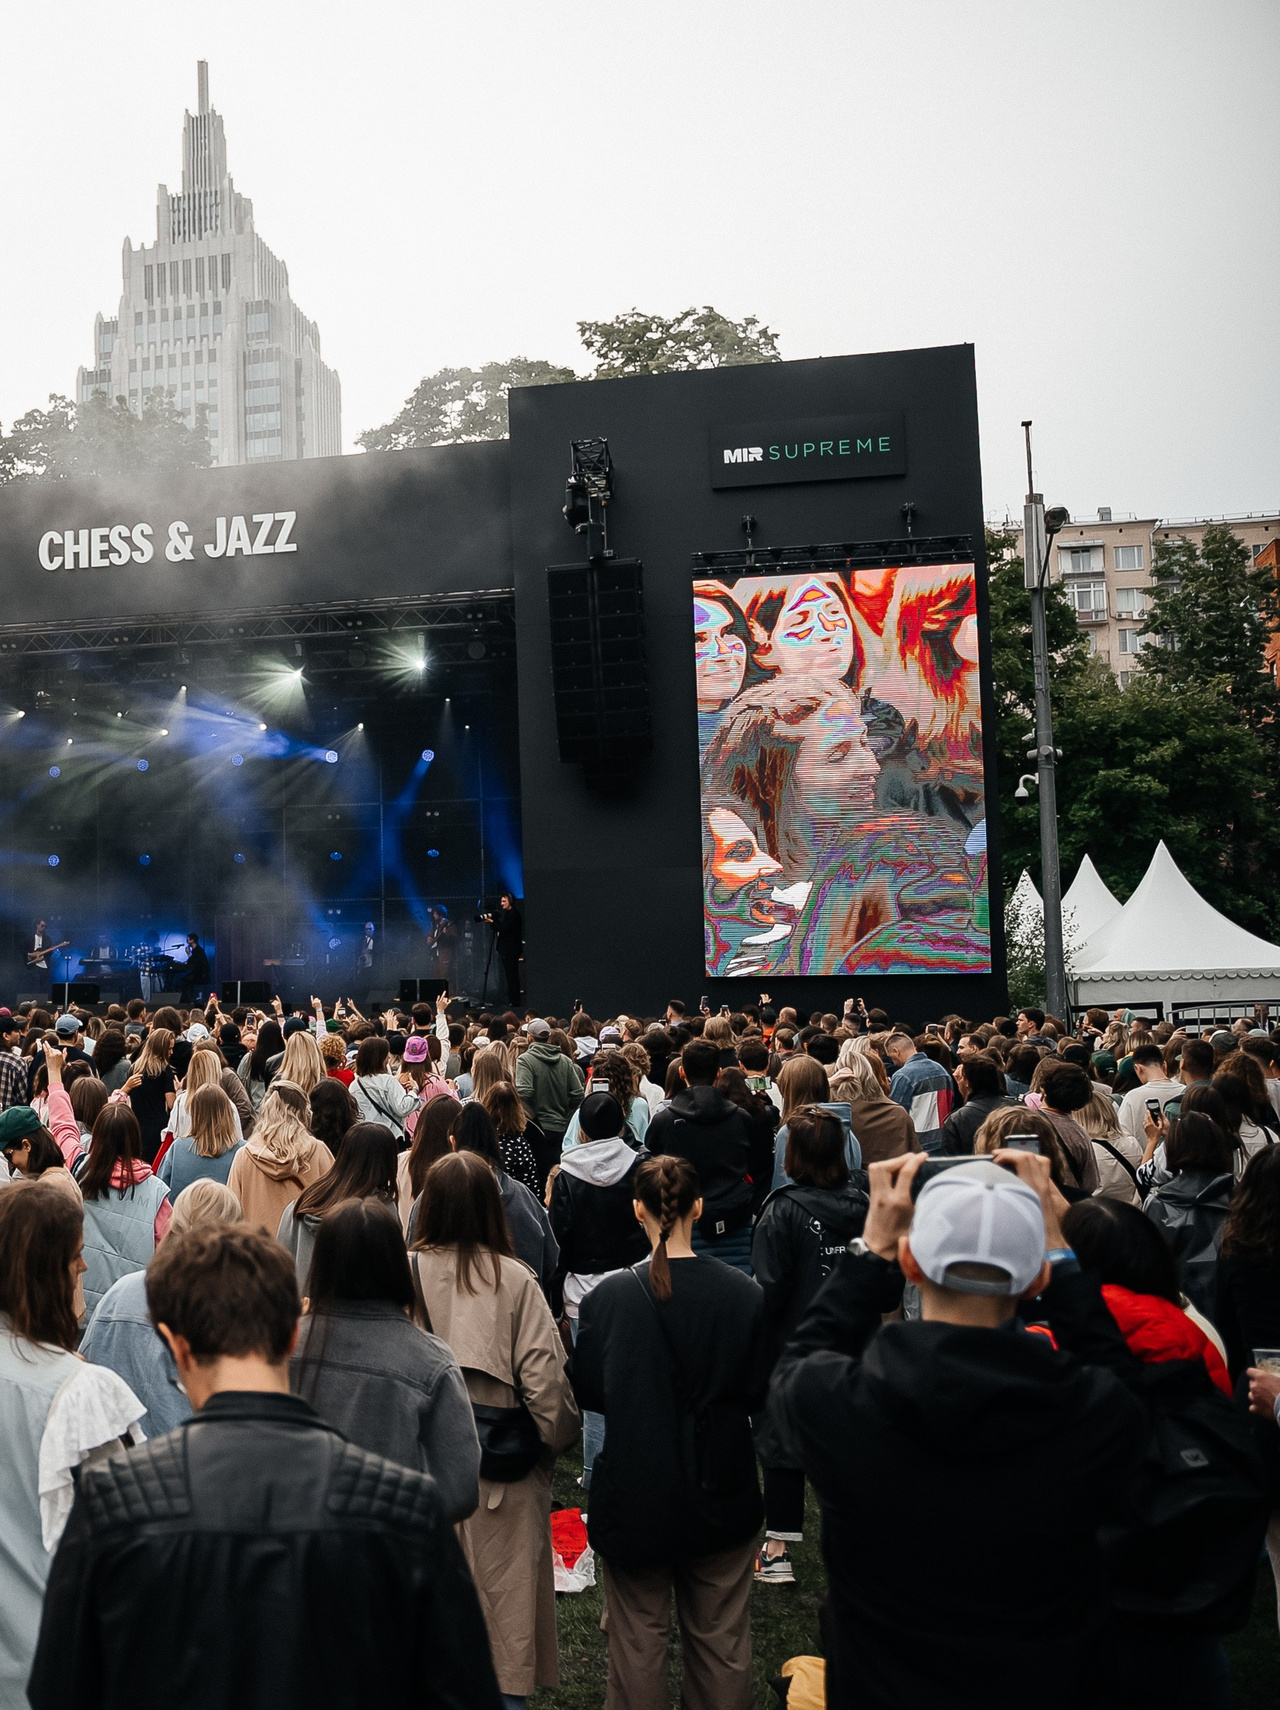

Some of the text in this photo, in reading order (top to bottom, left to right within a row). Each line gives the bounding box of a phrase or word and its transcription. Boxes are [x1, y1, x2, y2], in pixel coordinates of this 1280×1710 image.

[723, 436, 891, 464] MIR SUPREME
[38, 510, 297, 571] CHESS & JAZZ
